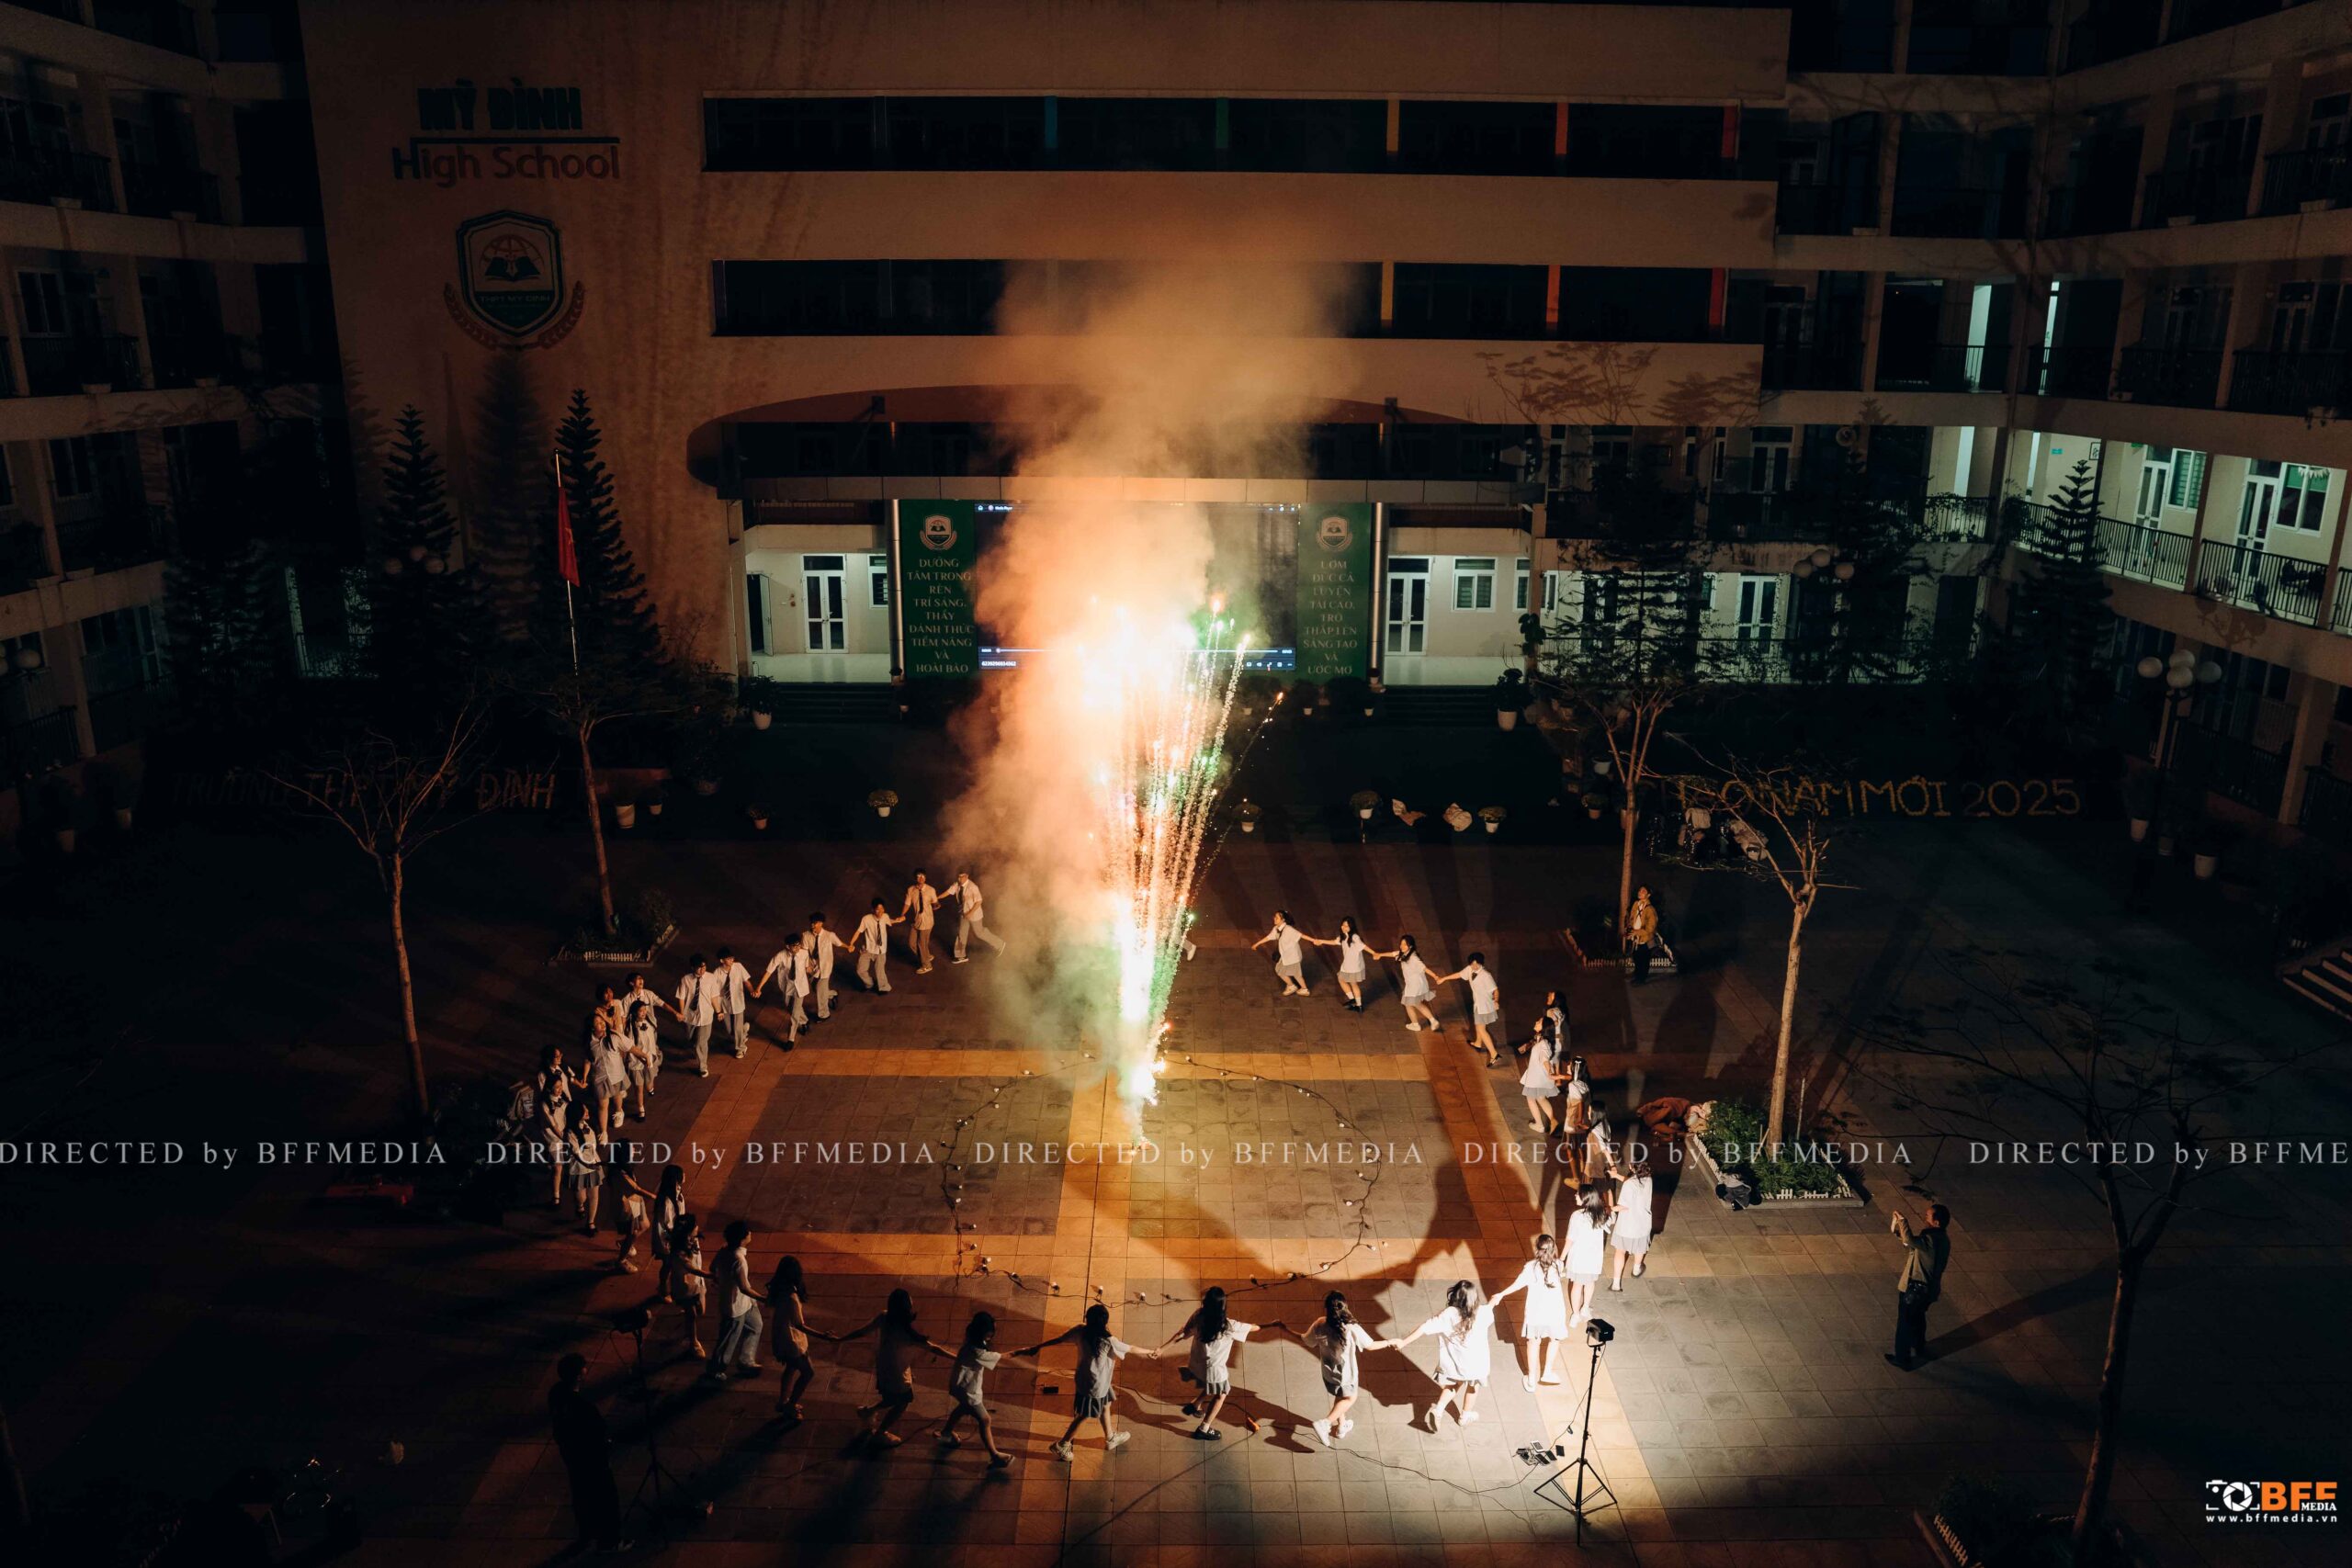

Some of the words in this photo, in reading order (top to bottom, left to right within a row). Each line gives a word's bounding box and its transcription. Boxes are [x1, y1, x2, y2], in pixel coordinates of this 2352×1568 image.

[392, 144, 481, 188] High
[492, 145, 621, 180] School
[933, 571, 971, 581] TRONG
[1858, 773, 1952, 818] MỚI
[1961, 778, 2082, 818] 2025
